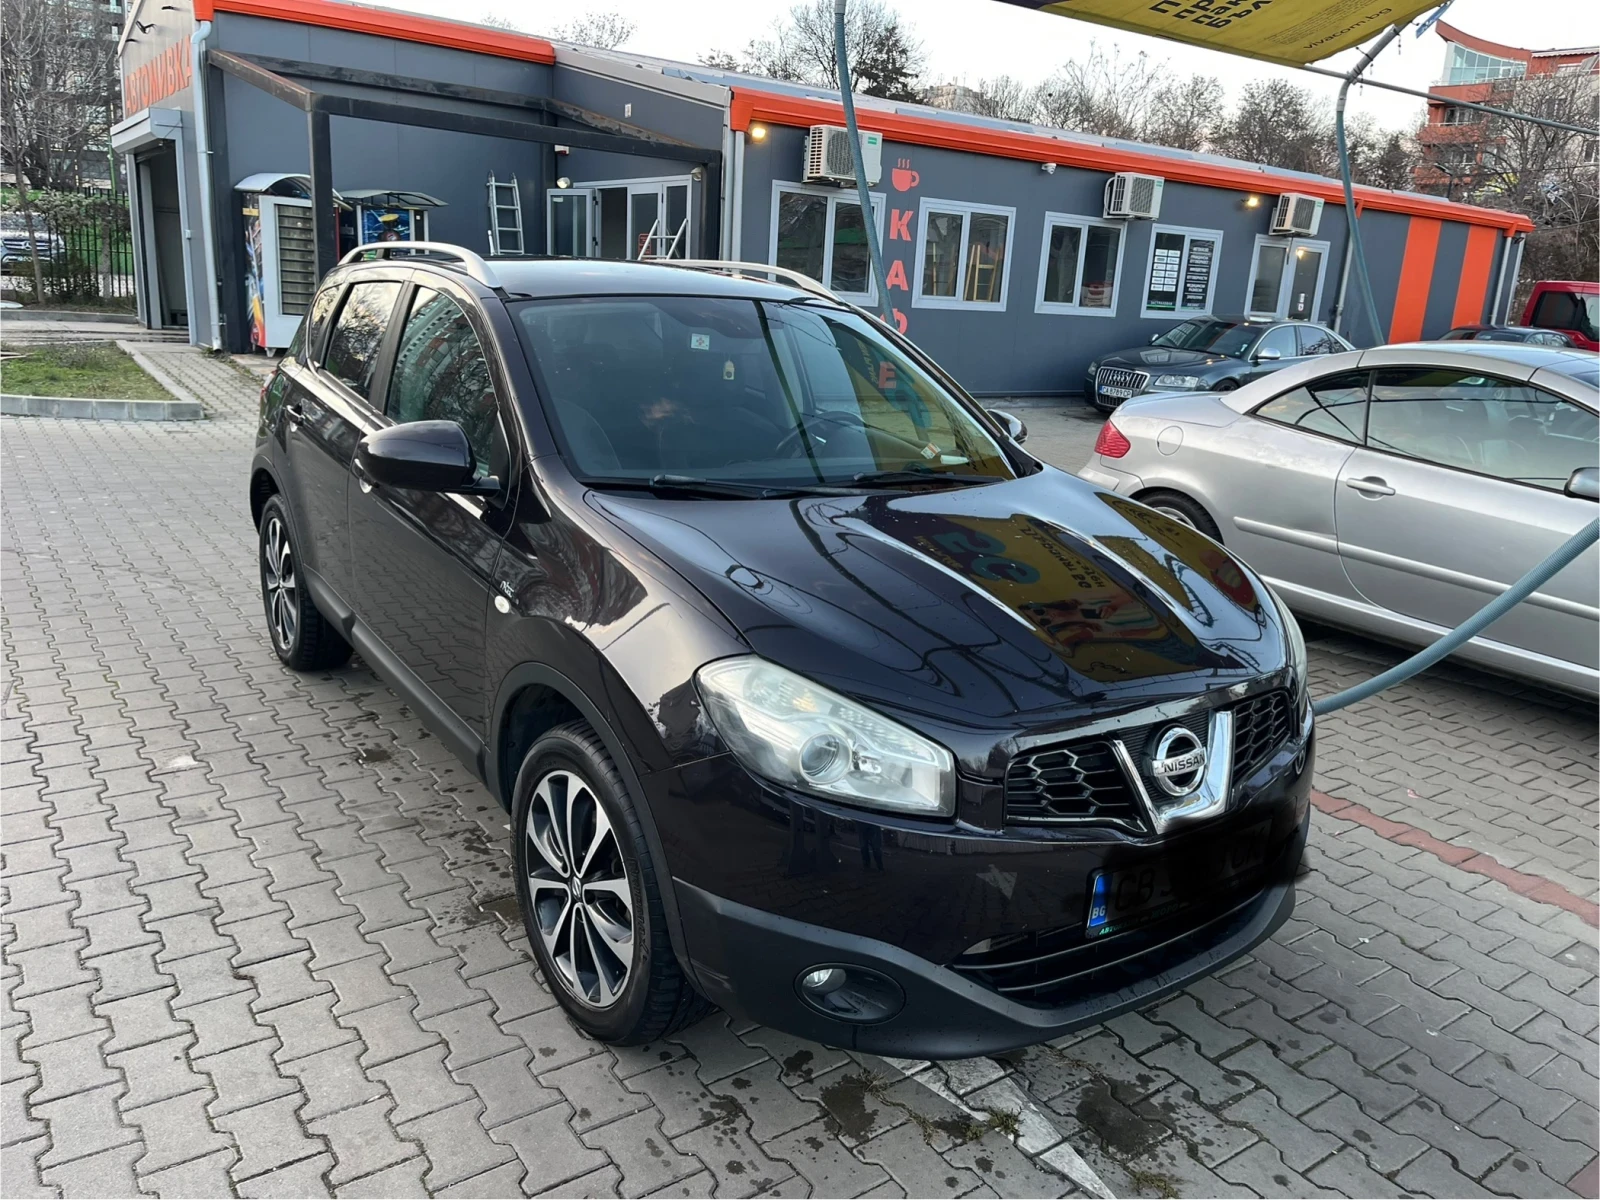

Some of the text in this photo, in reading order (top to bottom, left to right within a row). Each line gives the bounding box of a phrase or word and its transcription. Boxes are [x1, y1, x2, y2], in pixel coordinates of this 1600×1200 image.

[1303, 7, 1393, 49] vivacom.bg
[1163, 752, 1205, 773] NISSAN
[1092, 905, 1106, 919] BG
